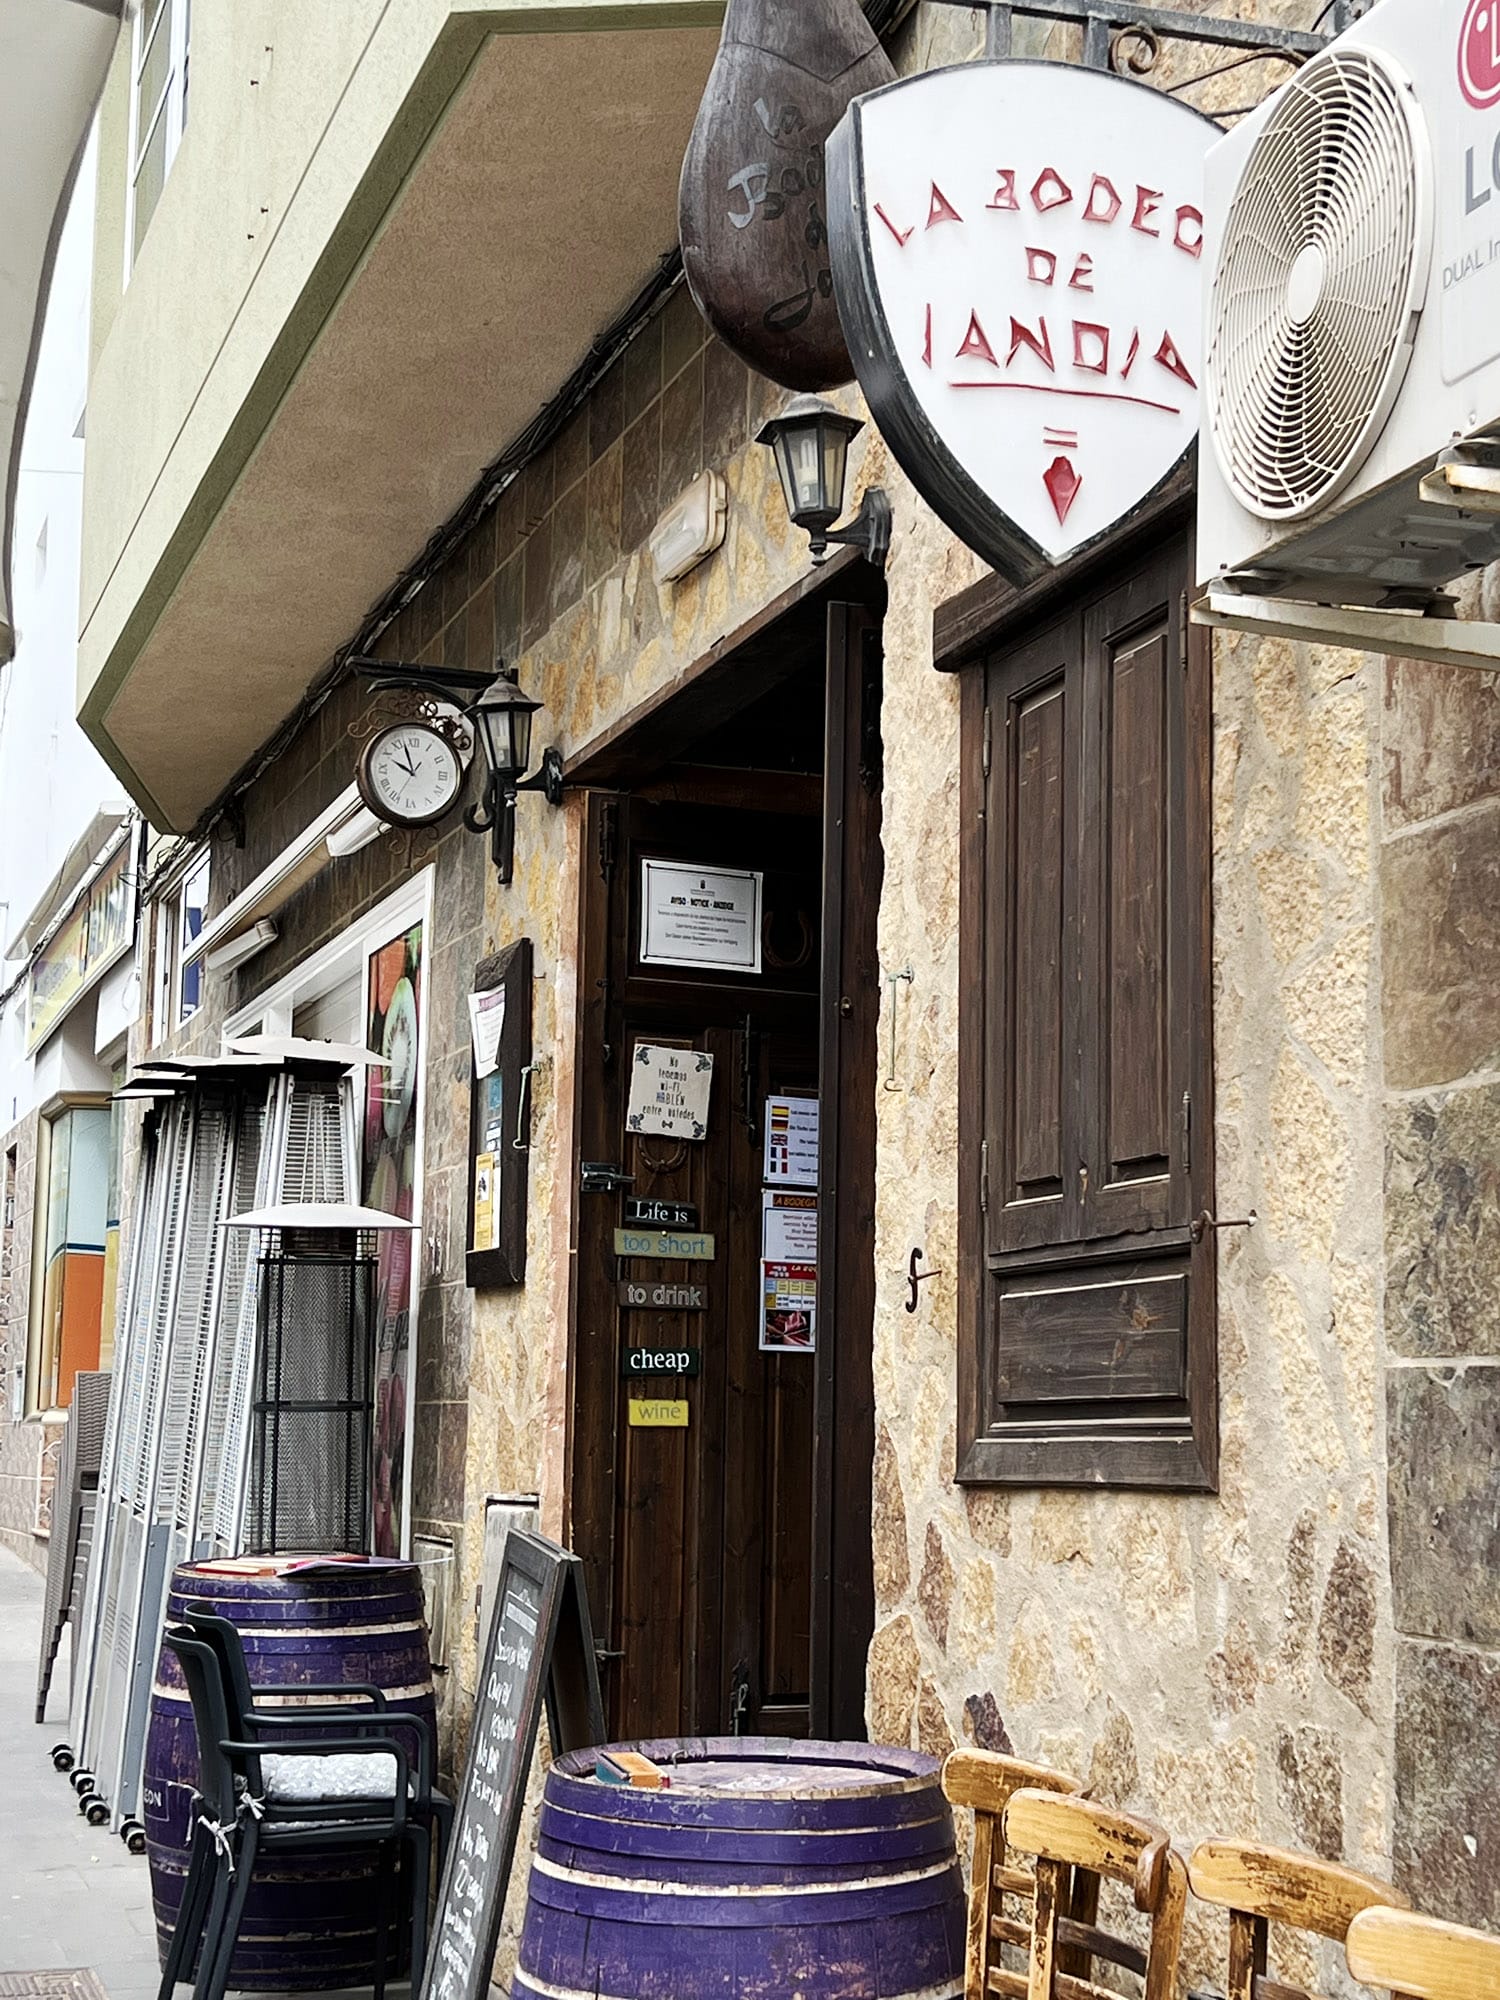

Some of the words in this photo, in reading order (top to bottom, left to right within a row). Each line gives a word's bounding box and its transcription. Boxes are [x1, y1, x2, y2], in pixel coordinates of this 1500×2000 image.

[873, 179, 964, 248] LA
[1025, 246, 1094, 293] DE
[1443, 249, 1484, 290] DUAL
[669, 1056, 678, 1068] No
[635, 1200, 669, 1221] Life
[675, 1204, 688, 1223] is
[623, 1234, 651, 1252] too
[658, 1235, 705, 1254] short
[627, 1284, 647, 1304] to
[652, 1284, 701, 1306] drink
[630, 1348, 690, 1373] cheap
[639, 1403, 681, 1420] wine
